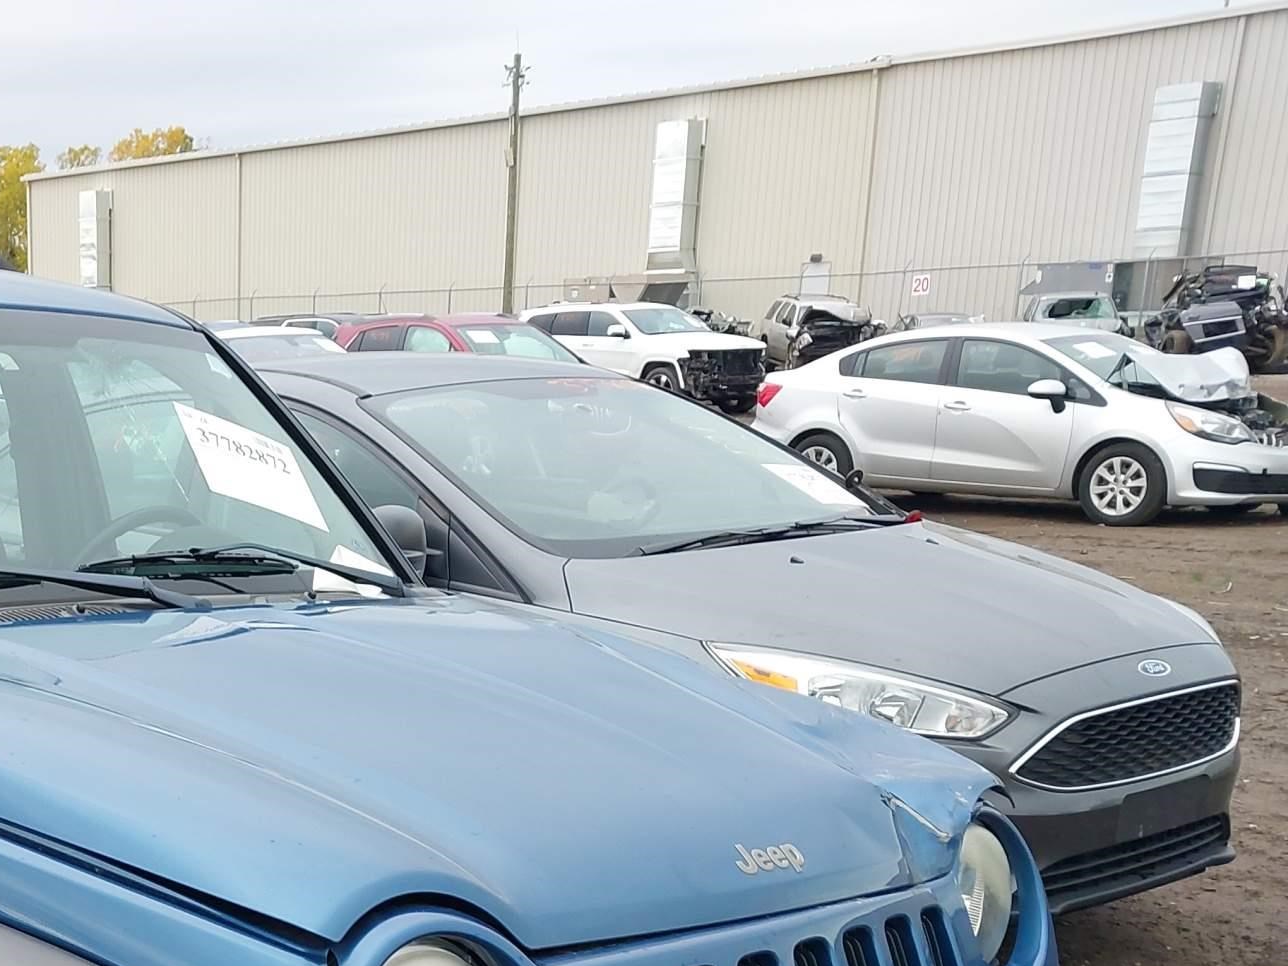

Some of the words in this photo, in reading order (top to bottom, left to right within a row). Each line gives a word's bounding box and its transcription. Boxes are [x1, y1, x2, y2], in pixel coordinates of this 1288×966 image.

[913, 277, 929, 292] 20
[196, 427, 291, 475] 37782872
[734, 843, 805, 875] Jeep
